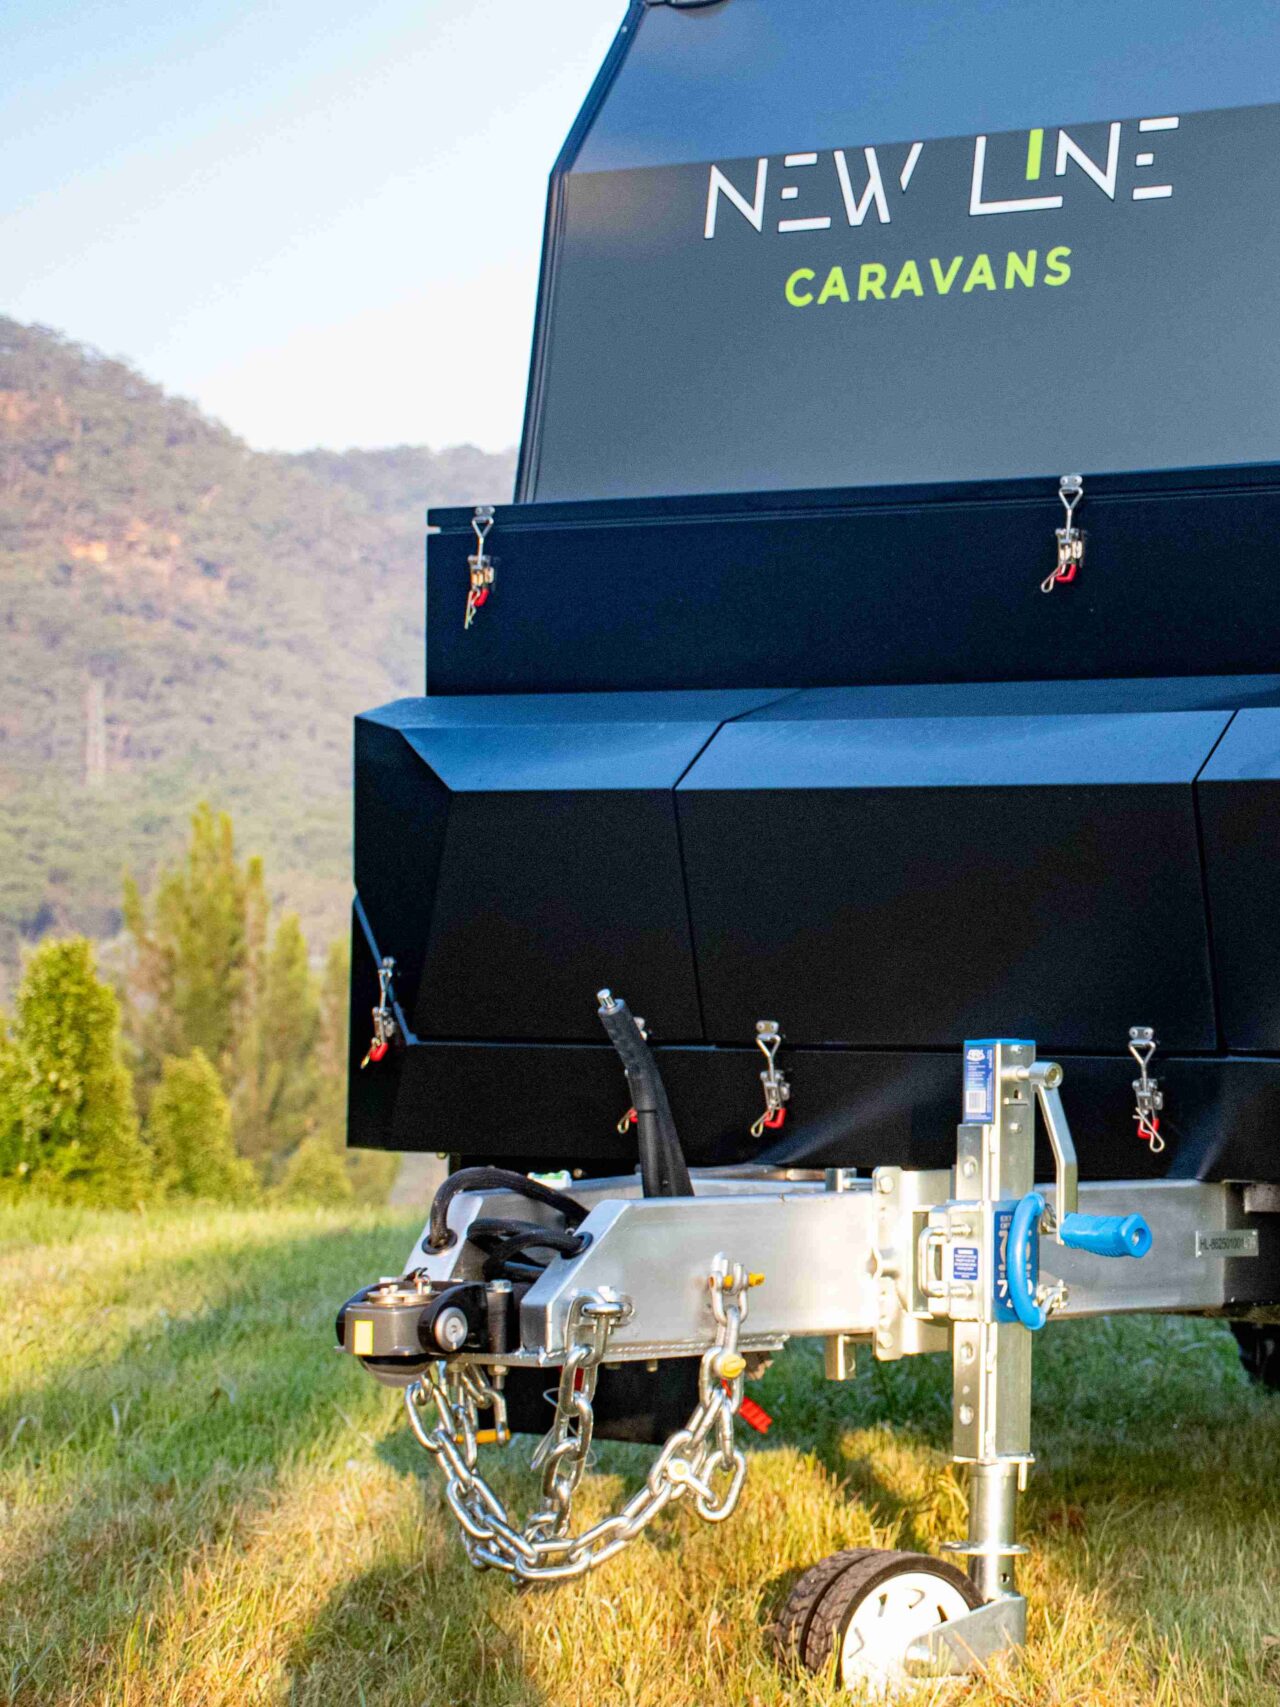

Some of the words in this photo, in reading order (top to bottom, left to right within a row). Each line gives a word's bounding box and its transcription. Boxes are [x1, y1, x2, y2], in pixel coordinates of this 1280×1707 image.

[704, 142, 923, 239] NEW
[969, 116, 1180, 216] LINE
[785, 246, 1072, 307] CARAVANS
